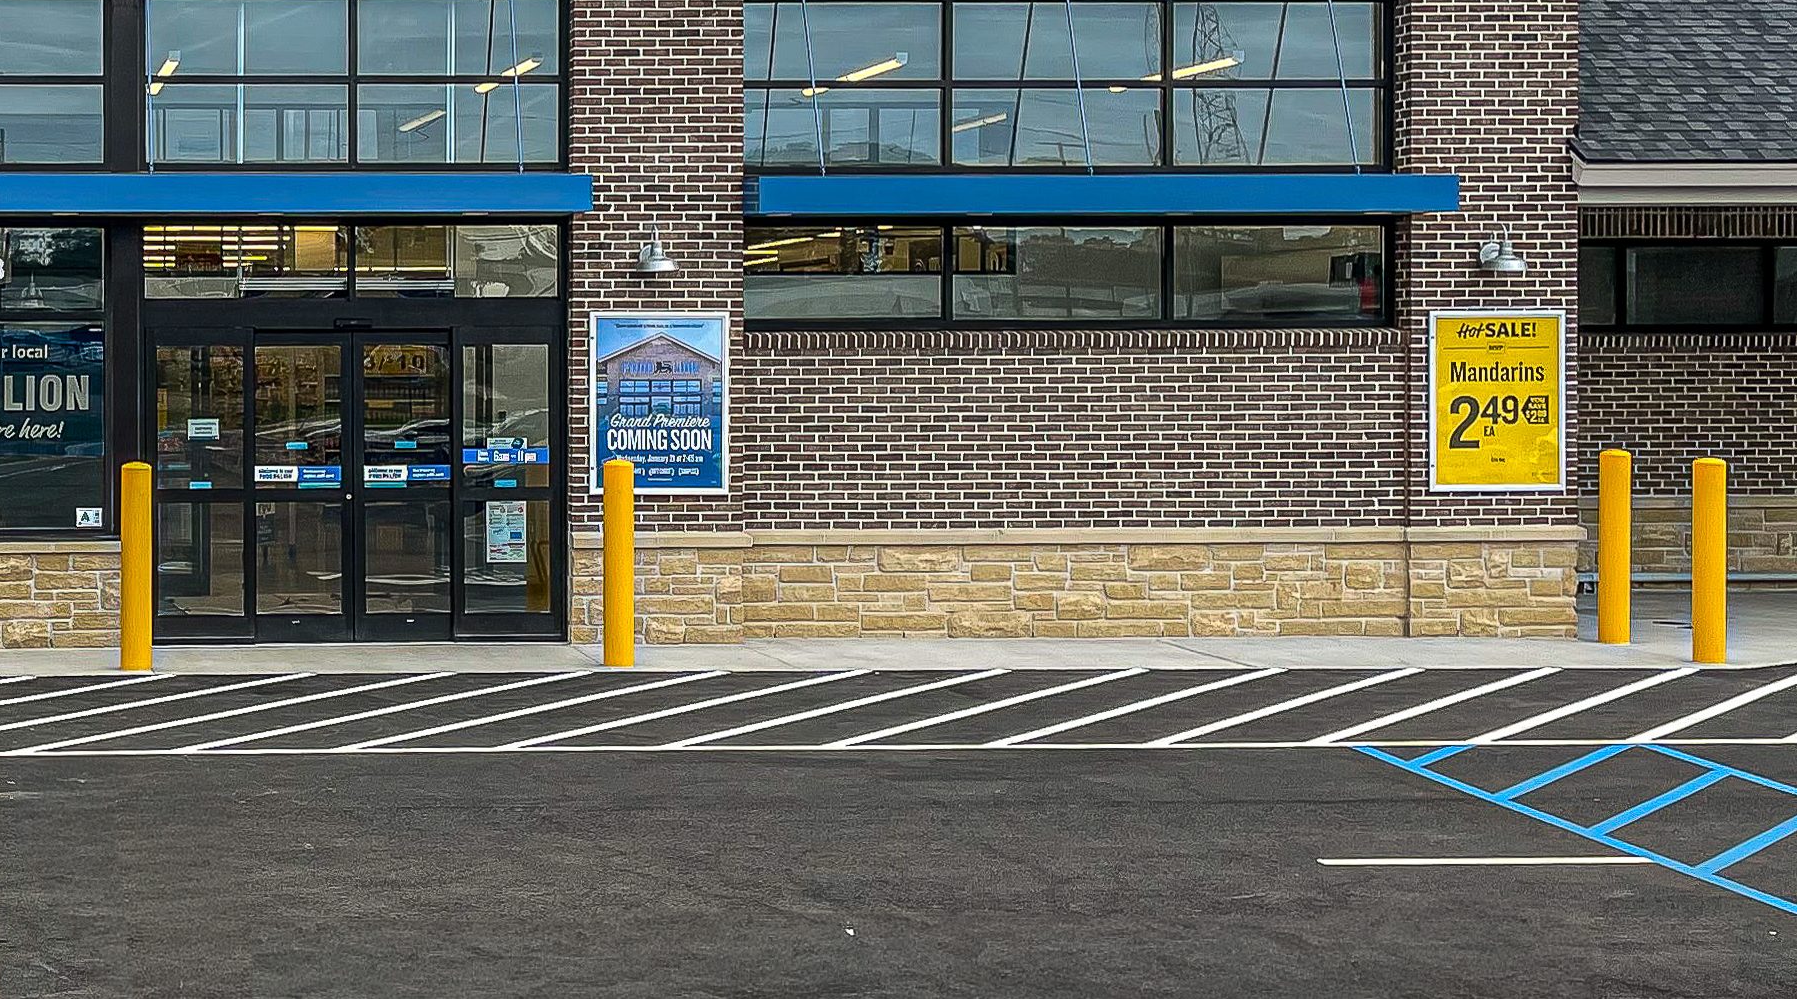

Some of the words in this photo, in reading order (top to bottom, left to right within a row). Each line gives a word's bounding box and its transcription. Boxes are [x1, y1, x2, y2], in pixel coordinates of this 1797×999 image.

[1456, 323, 1485, 339] Hot
[1485, 322, 1536, 338] SALE!
[12, 344, 49, 359] local
[1450, 361, 1545, 382] Mandarins
[3, 374, 91, 412] LION
[610, 413, 653, 427] Grand
[653, 413, 711, 427] Premiere
[18, 418, 65, 440] here!
[1483, 426, 1495, 436] EA
[607, 429, 668, 450] COMING
[670, 429, 712, 450] SOON
[81, 512, 90, 522] A
